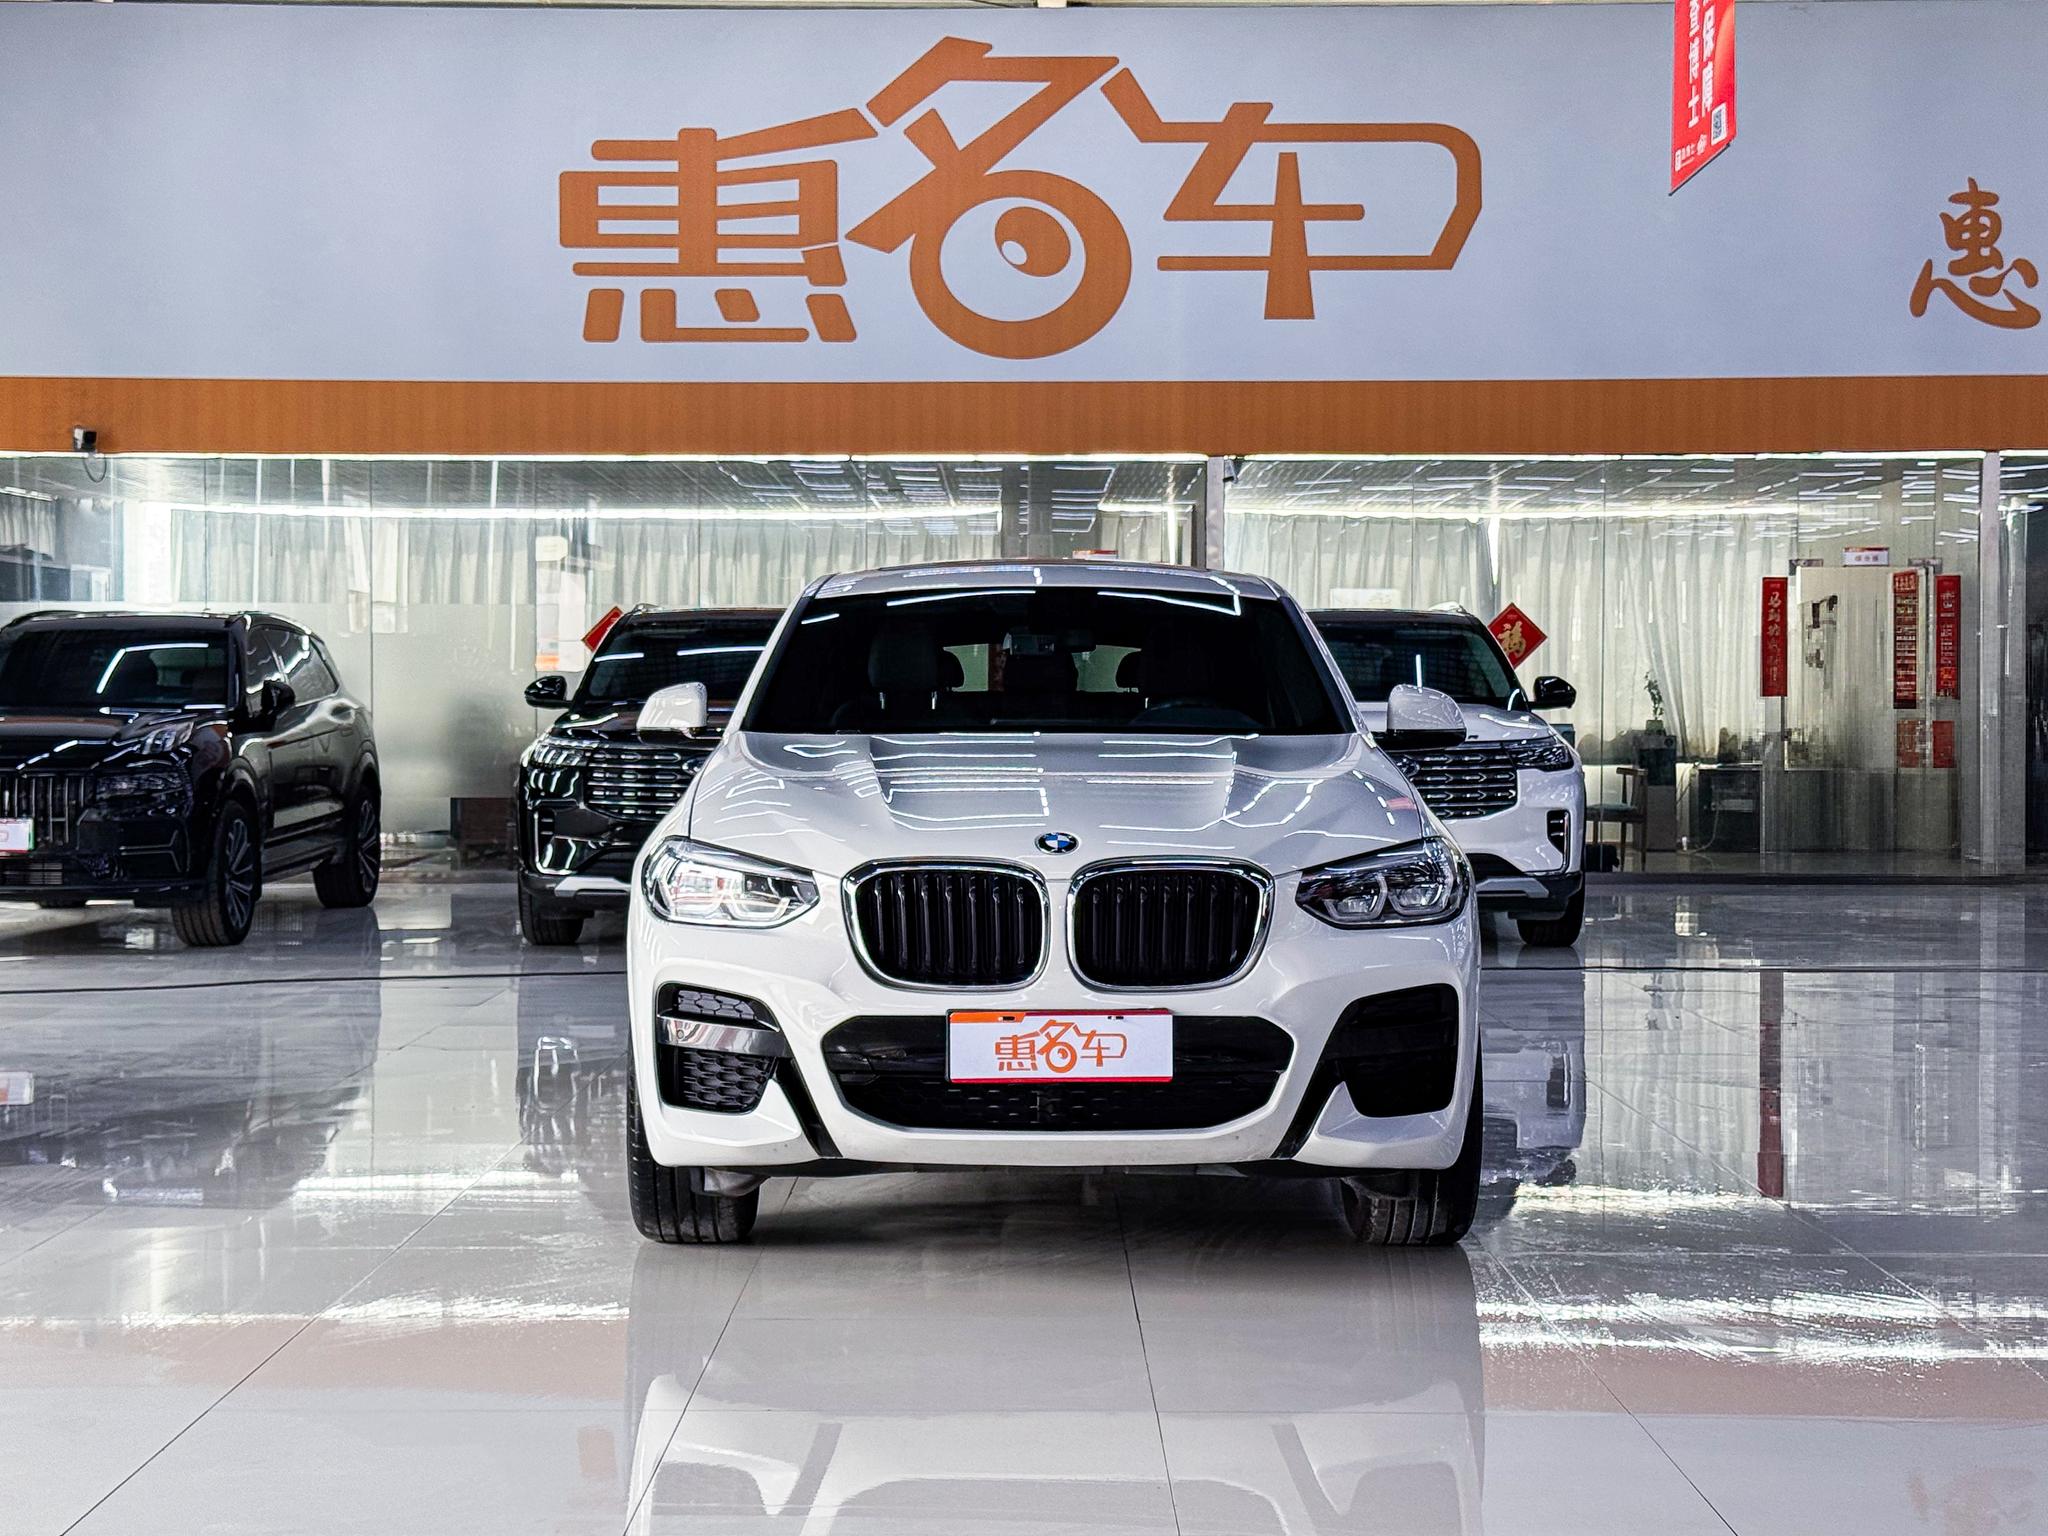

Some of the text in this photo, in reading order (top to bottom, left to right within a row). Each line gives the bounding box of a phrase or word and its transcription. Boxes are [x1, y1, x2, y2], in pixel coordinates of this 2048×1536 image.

[559, 36, 1482, 360] 惠名车
[1910, 176, 2041, 329] 惠
[995, 1020, 1127, 1073] 惠名车
